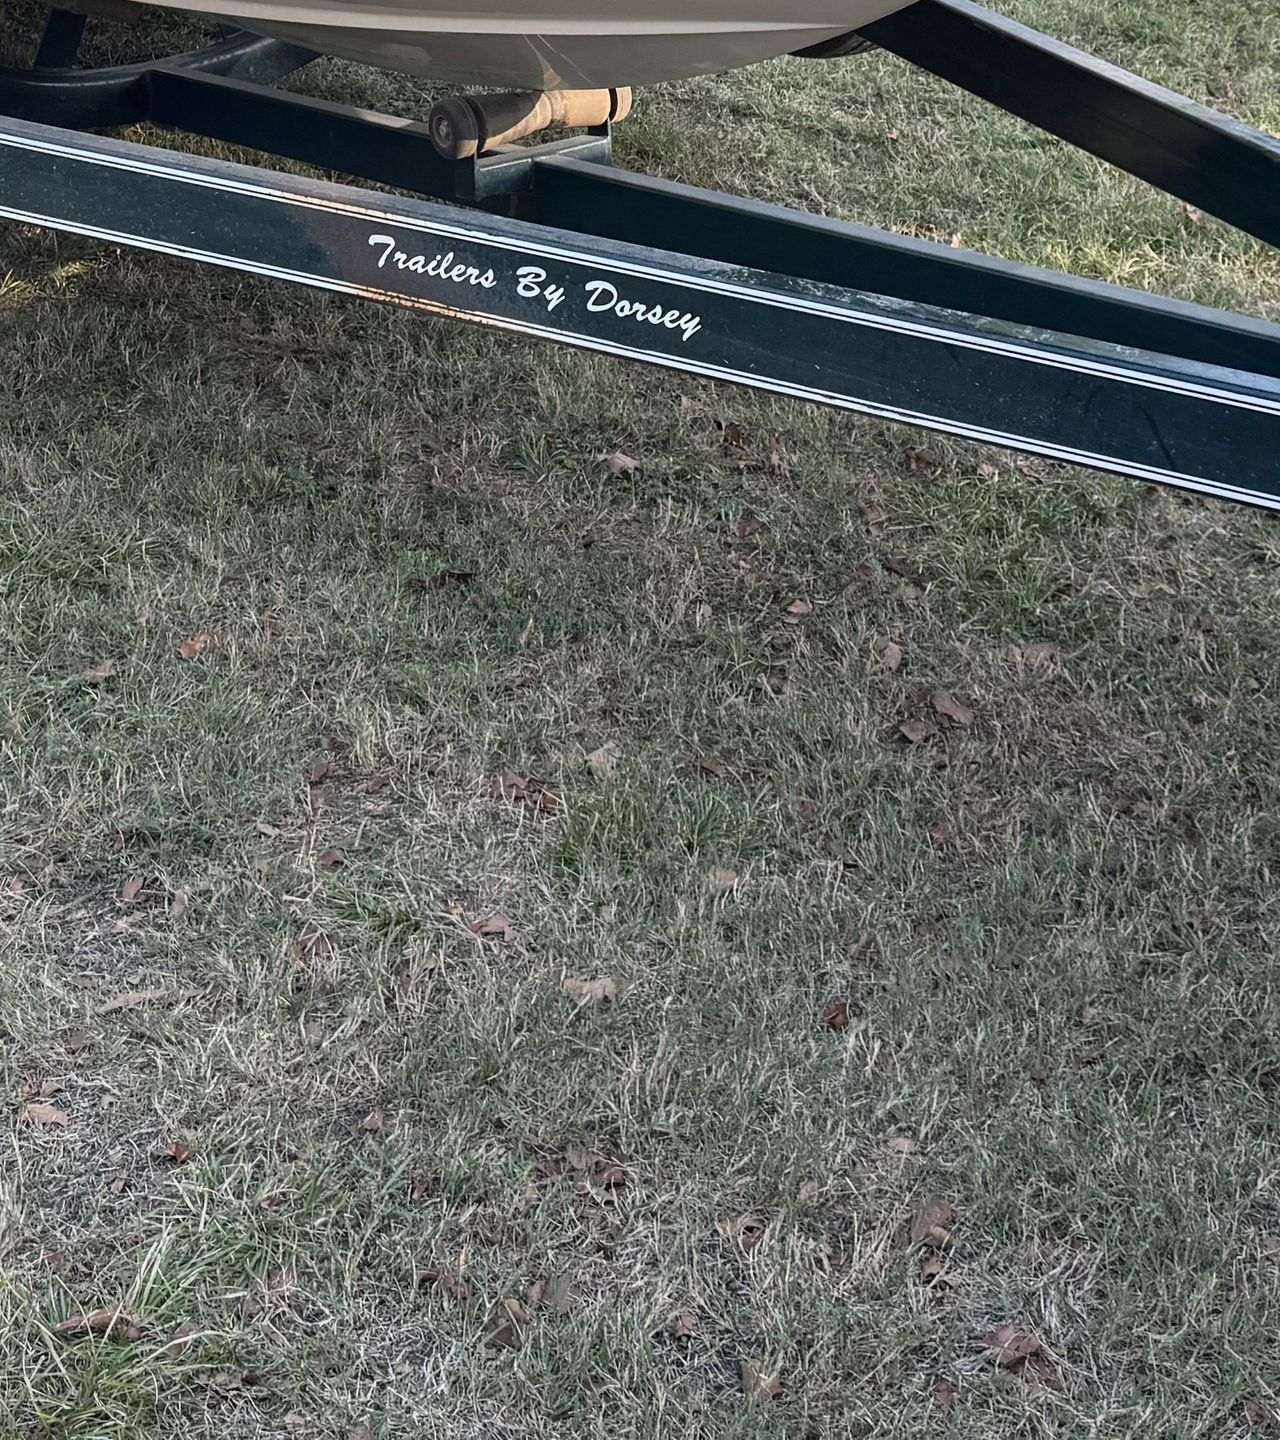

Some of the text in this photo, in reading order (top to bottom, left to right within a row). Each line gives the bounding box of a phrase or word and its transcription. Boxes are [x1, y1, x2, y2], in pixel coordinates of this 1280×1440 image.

[367, 233, 704, 342] Trailers By Dorsey
